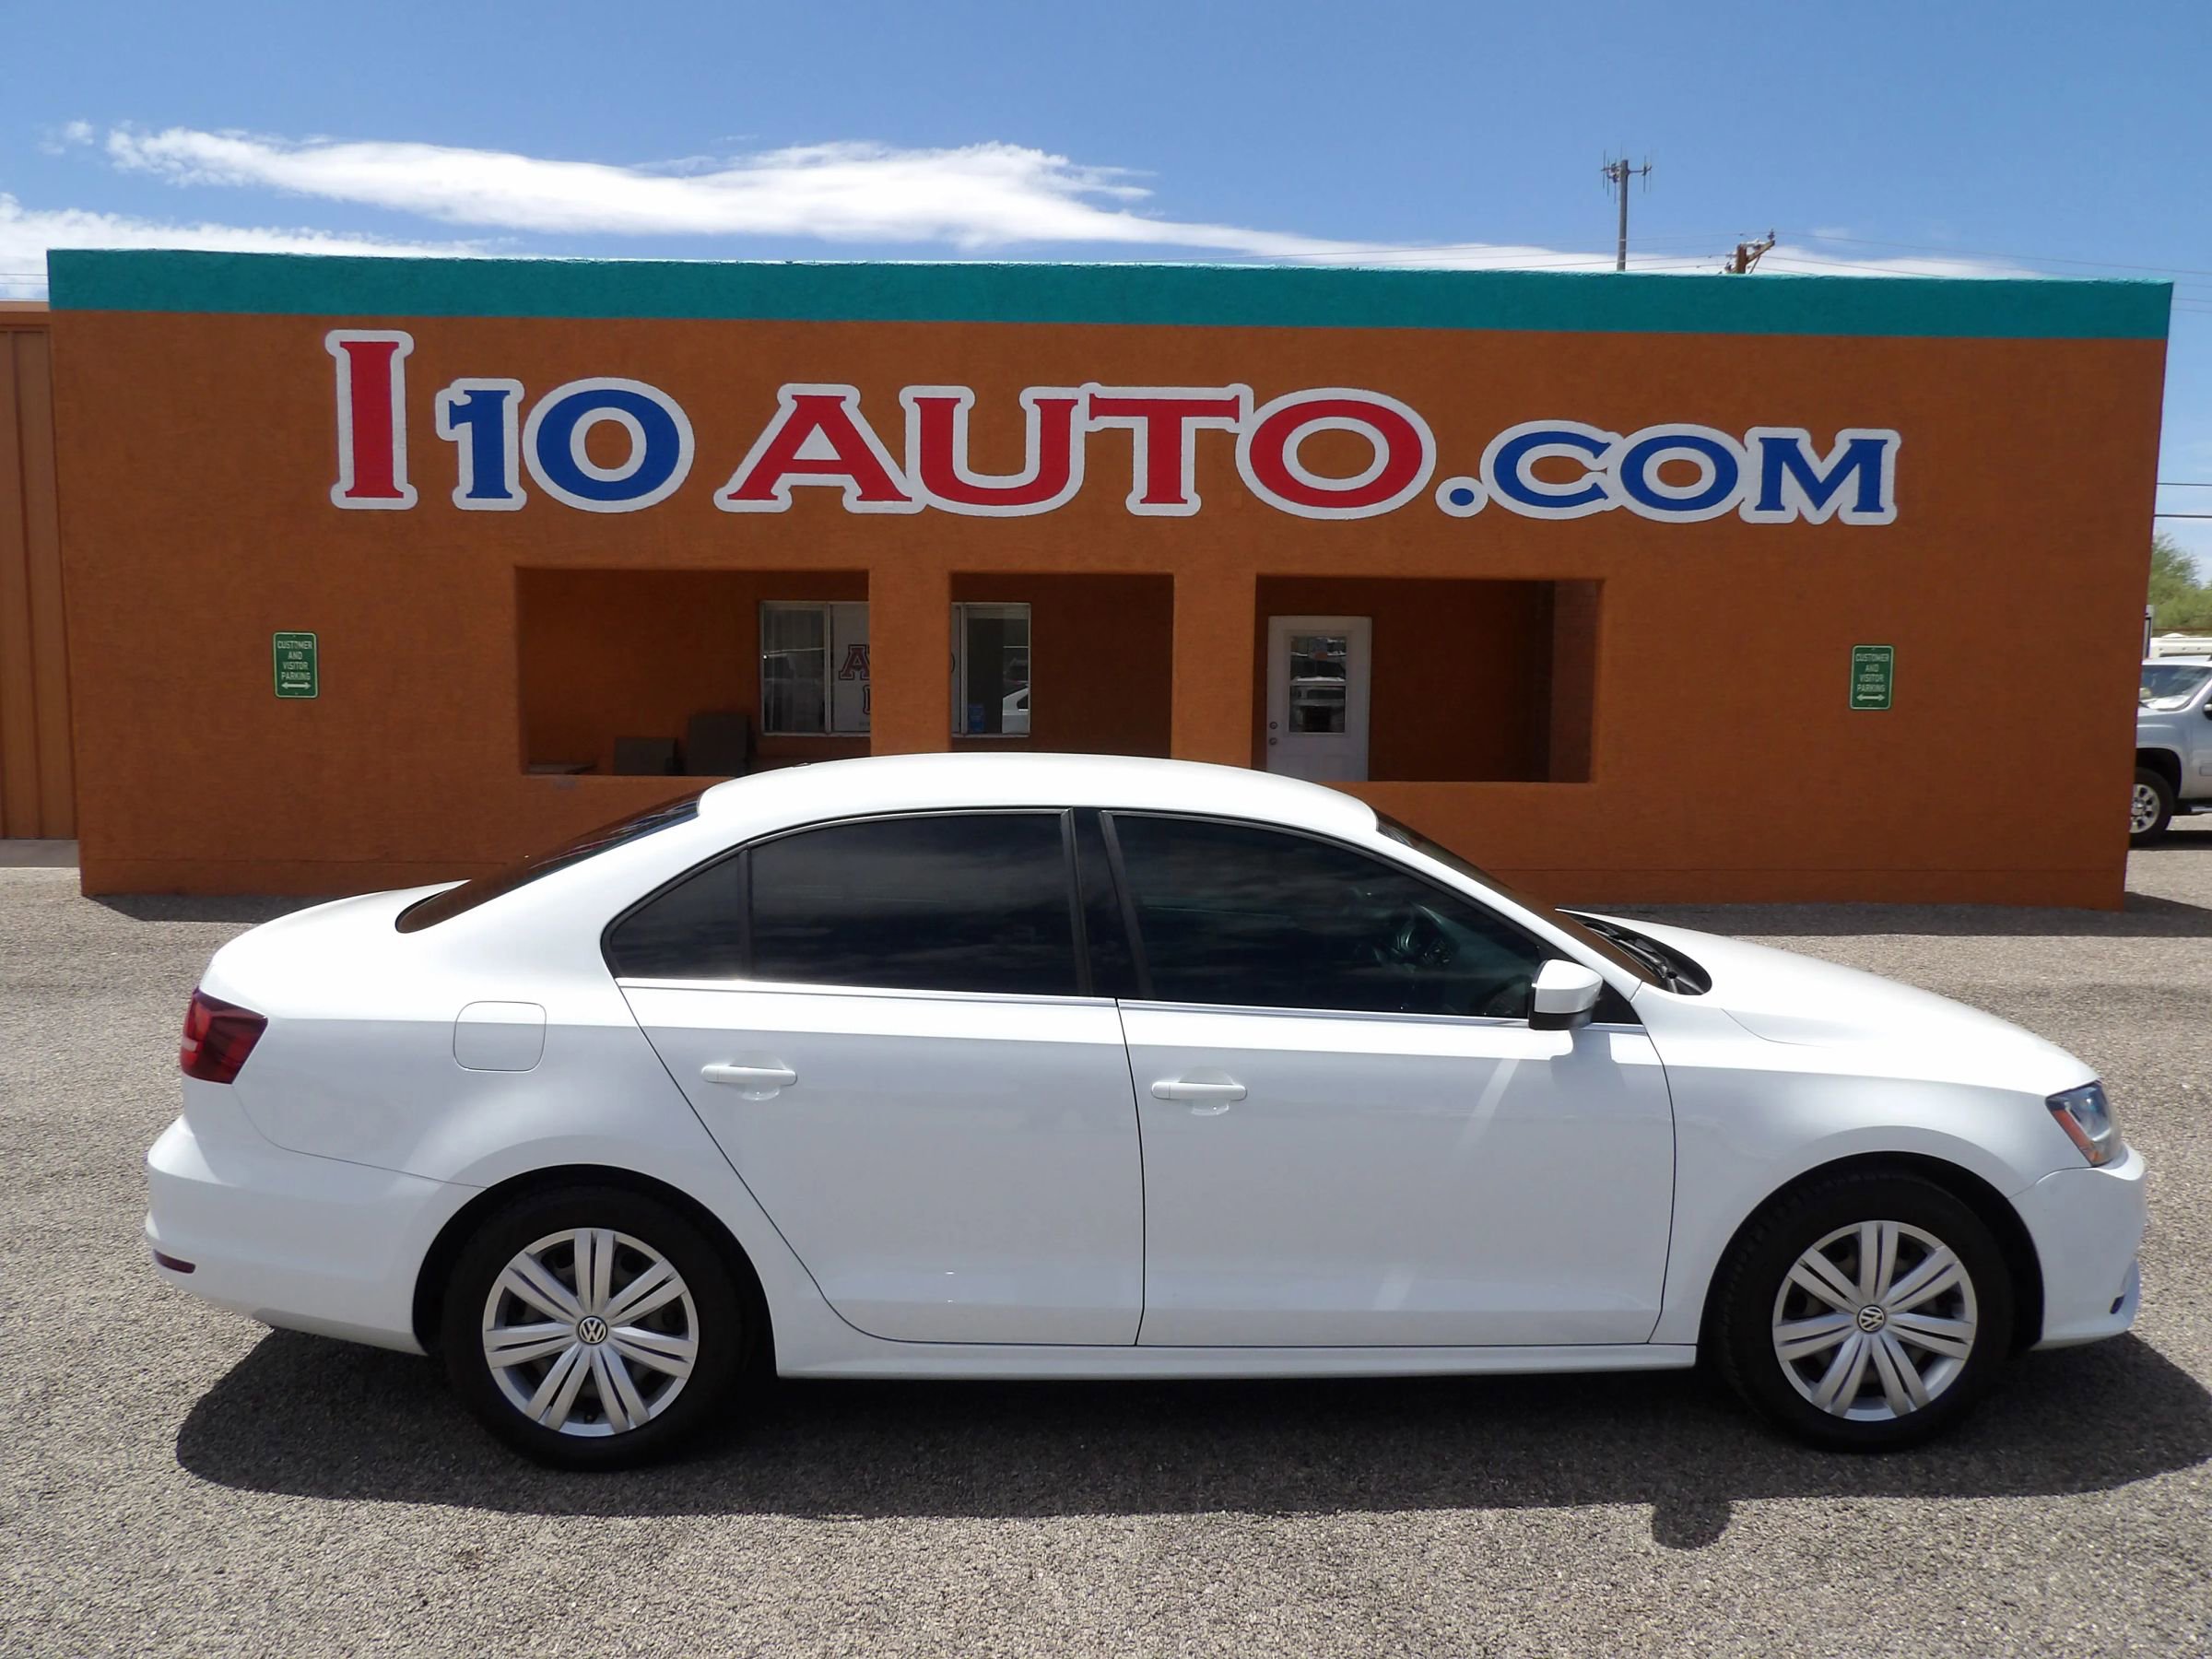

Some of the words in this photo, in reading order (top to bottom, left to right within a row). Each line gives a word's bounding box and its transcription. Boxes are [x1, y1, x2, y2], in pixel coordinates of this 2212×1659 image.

[713, 383, 1901, 525] AUTO.COM
[277, 641, 312, 650] CUSTOMER
[288, 651, 303, 660] AND
[282, 662, 309, 670] VISITOR
[1865, 664, 1879, 673] AND
[281, 672, 311, 680] PARKING
[1856, 684, 1886, 693] PARKING
[579, 1317, 606, 1344] VW
